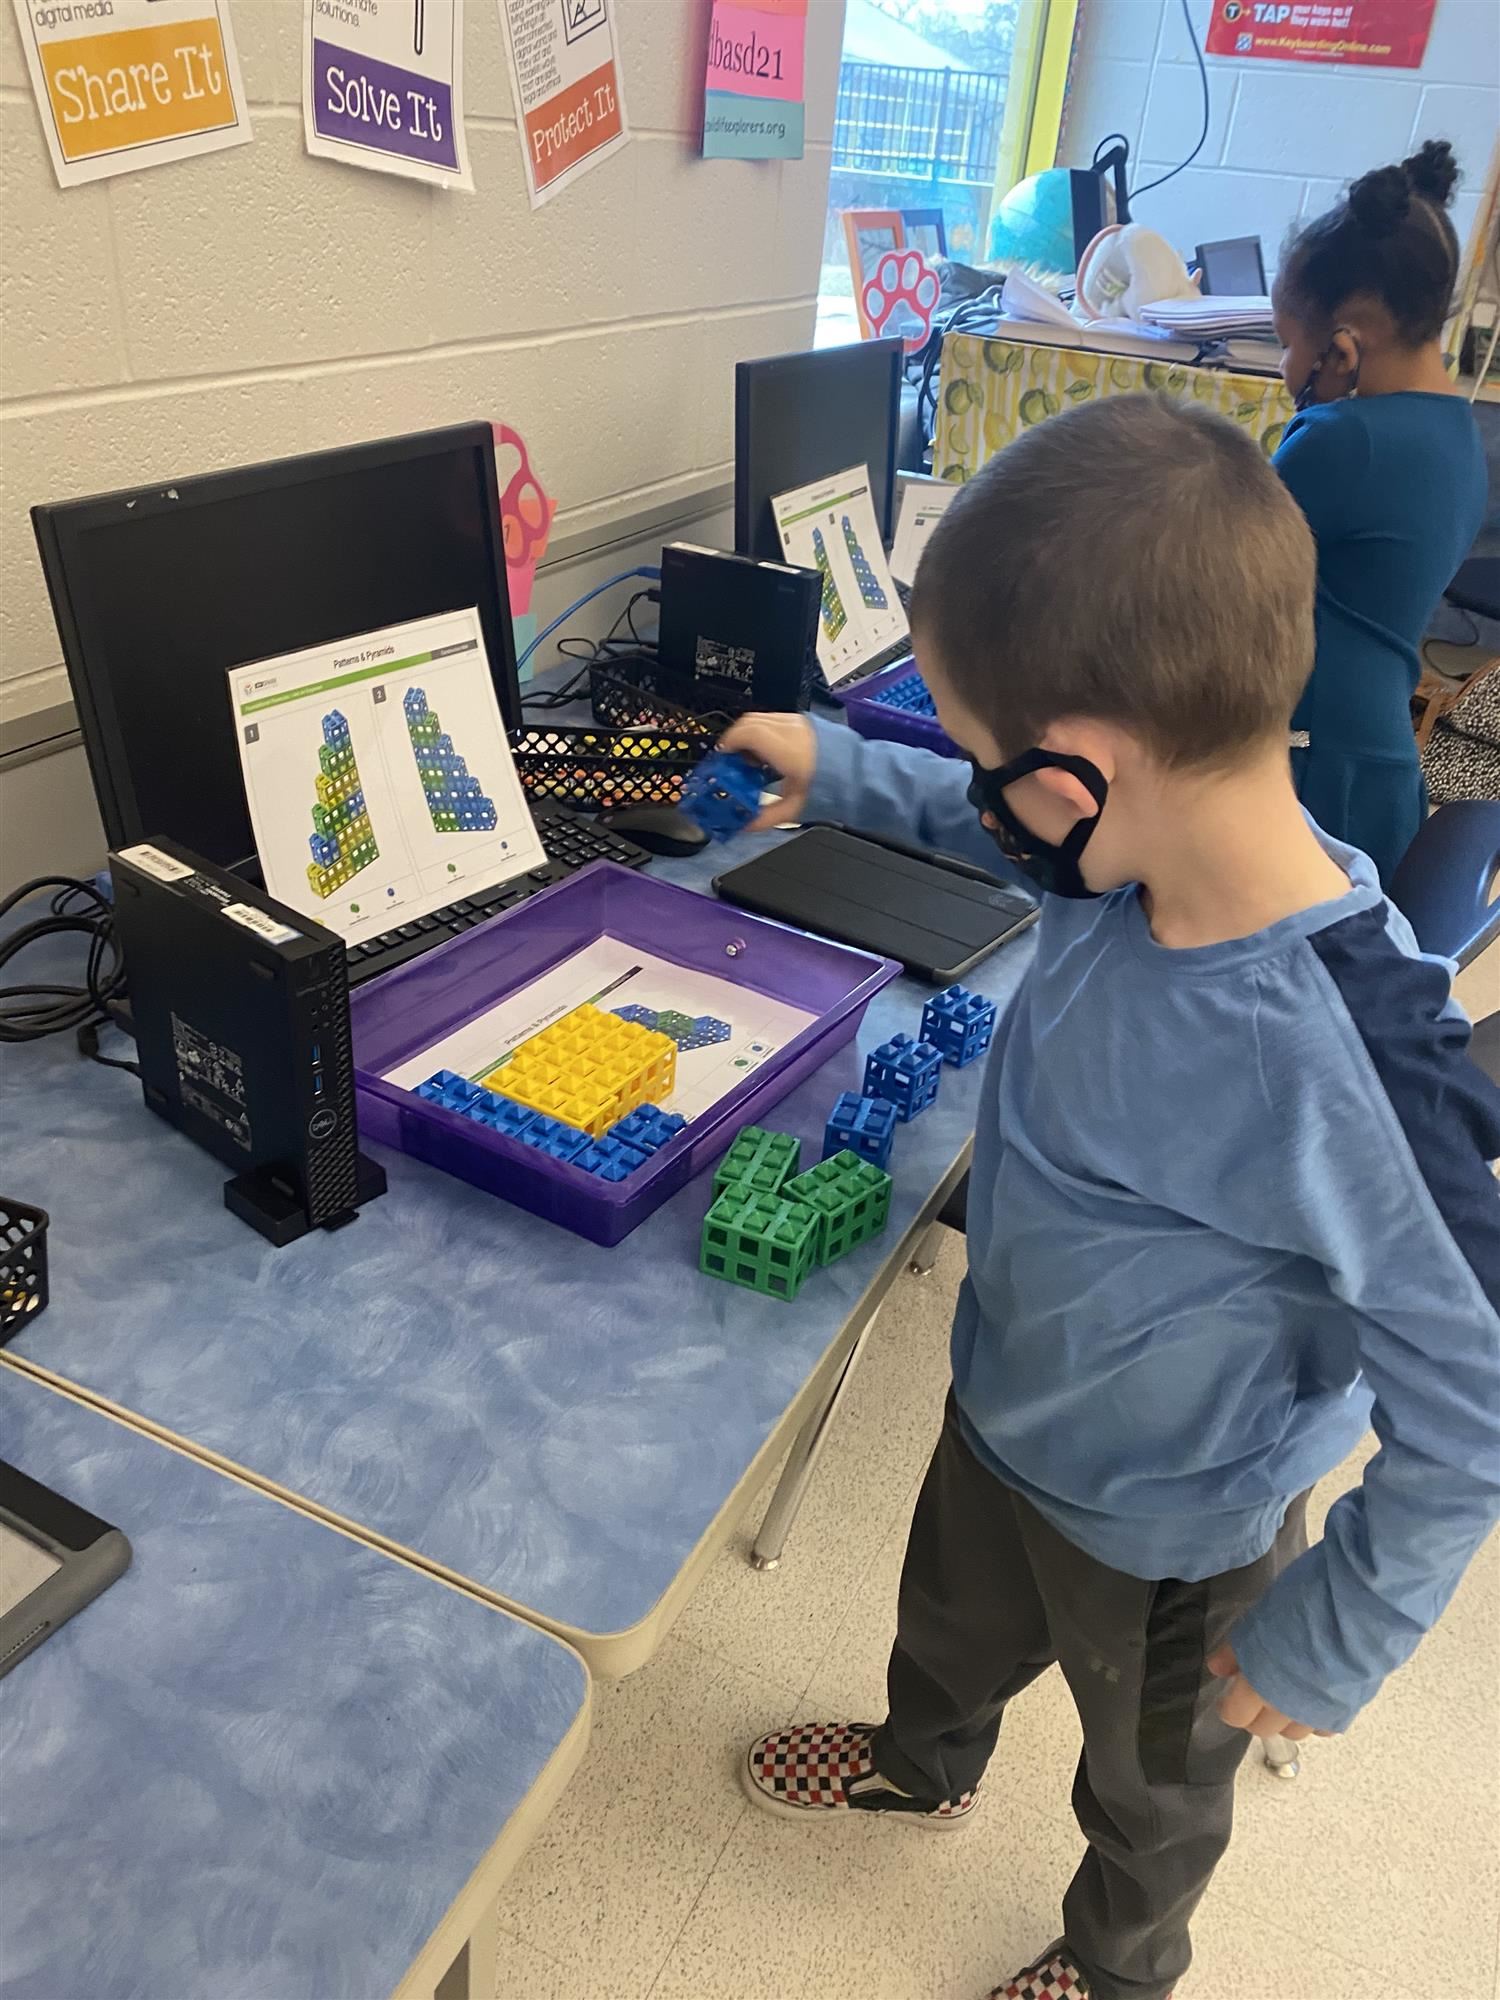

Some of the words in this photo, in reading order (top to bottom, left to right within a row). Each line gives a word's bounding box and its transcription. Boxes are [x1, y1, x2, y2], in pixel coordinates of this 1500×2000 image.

[35, 4, 73, 28] digital
[73, 0, 114, 19] media
[1254, 4, 1290, 23] TAP
[54, 62, 173, 124] Share
[174, 44, 223, 101] It
[326, 65, 402, 131] Solve
[405, 90, 443, 143] It
[532, 97, 593, 164] Protect
[594, 83, 615, 121] It
[333, 655, 360, 669] Patterns
[366, 645, 395, 661] Pyramids
[312, 1117, 335, 1131] DELL
